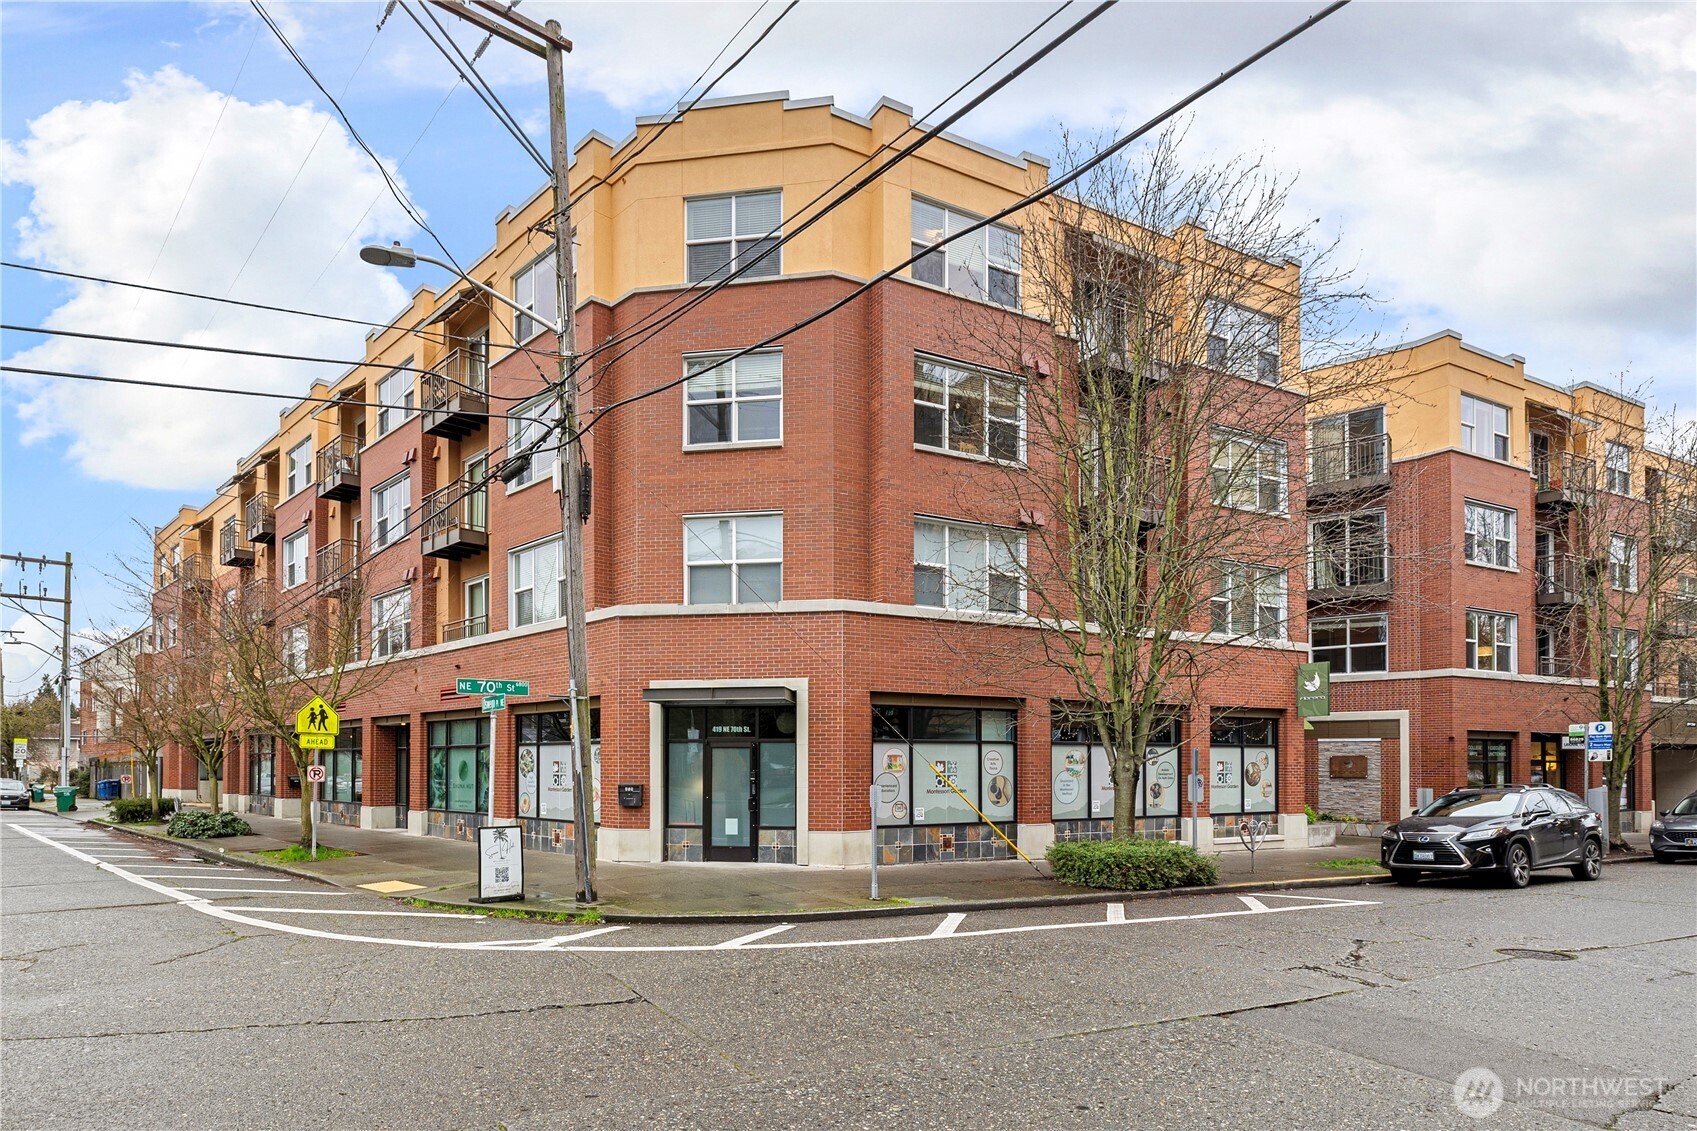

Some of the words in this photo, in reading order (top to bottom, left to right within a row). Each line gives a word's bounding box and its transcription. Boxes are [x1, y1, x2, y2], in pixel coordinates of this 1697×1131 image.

[460, 682, 472, 690] NE
[477, 681, 502, 692] 70th
[506, 684, 515, 692] St
